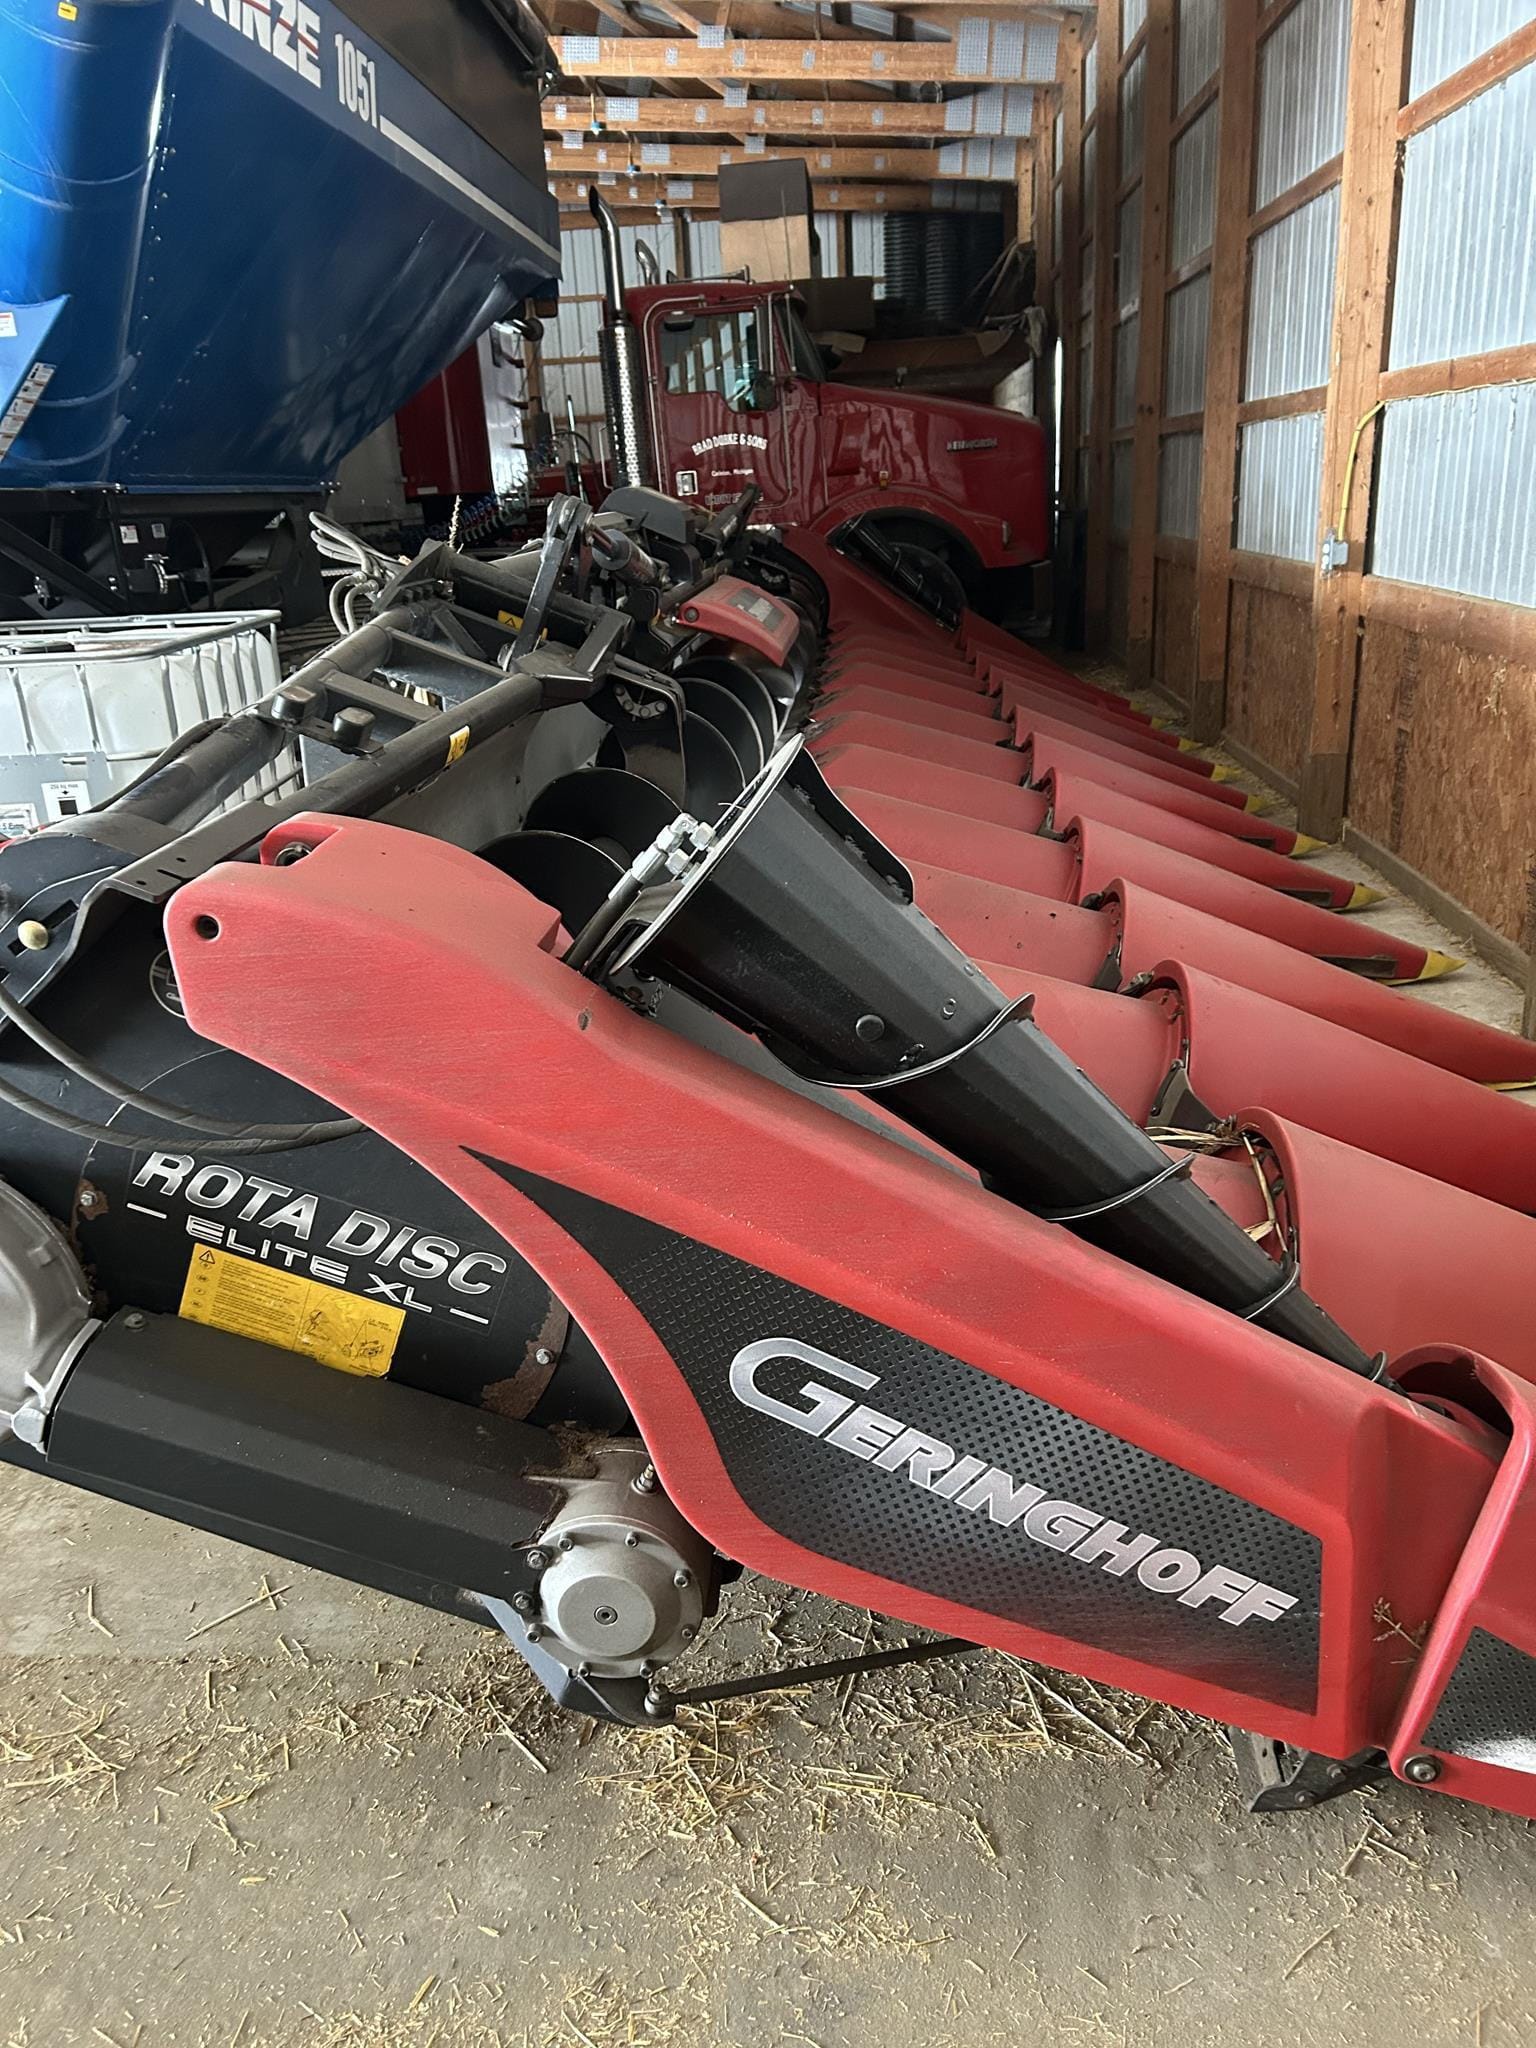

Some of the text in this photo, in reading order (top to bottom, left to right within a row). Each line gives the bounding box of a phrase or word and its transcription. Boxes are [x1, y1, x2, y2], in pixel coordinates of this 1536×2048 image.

[335, 33, 378, 129] 1051
[739, 433, 747, 446] &
[746, 434, 768, 450] SONS
[132, 1151, 508, 1295] ROTA DISC
[185, 1215, 349, 1284] ELITE
[363, 1272, 433, 1313] XL
[729, 1336, 1300, 1626] GERINGHOFF
